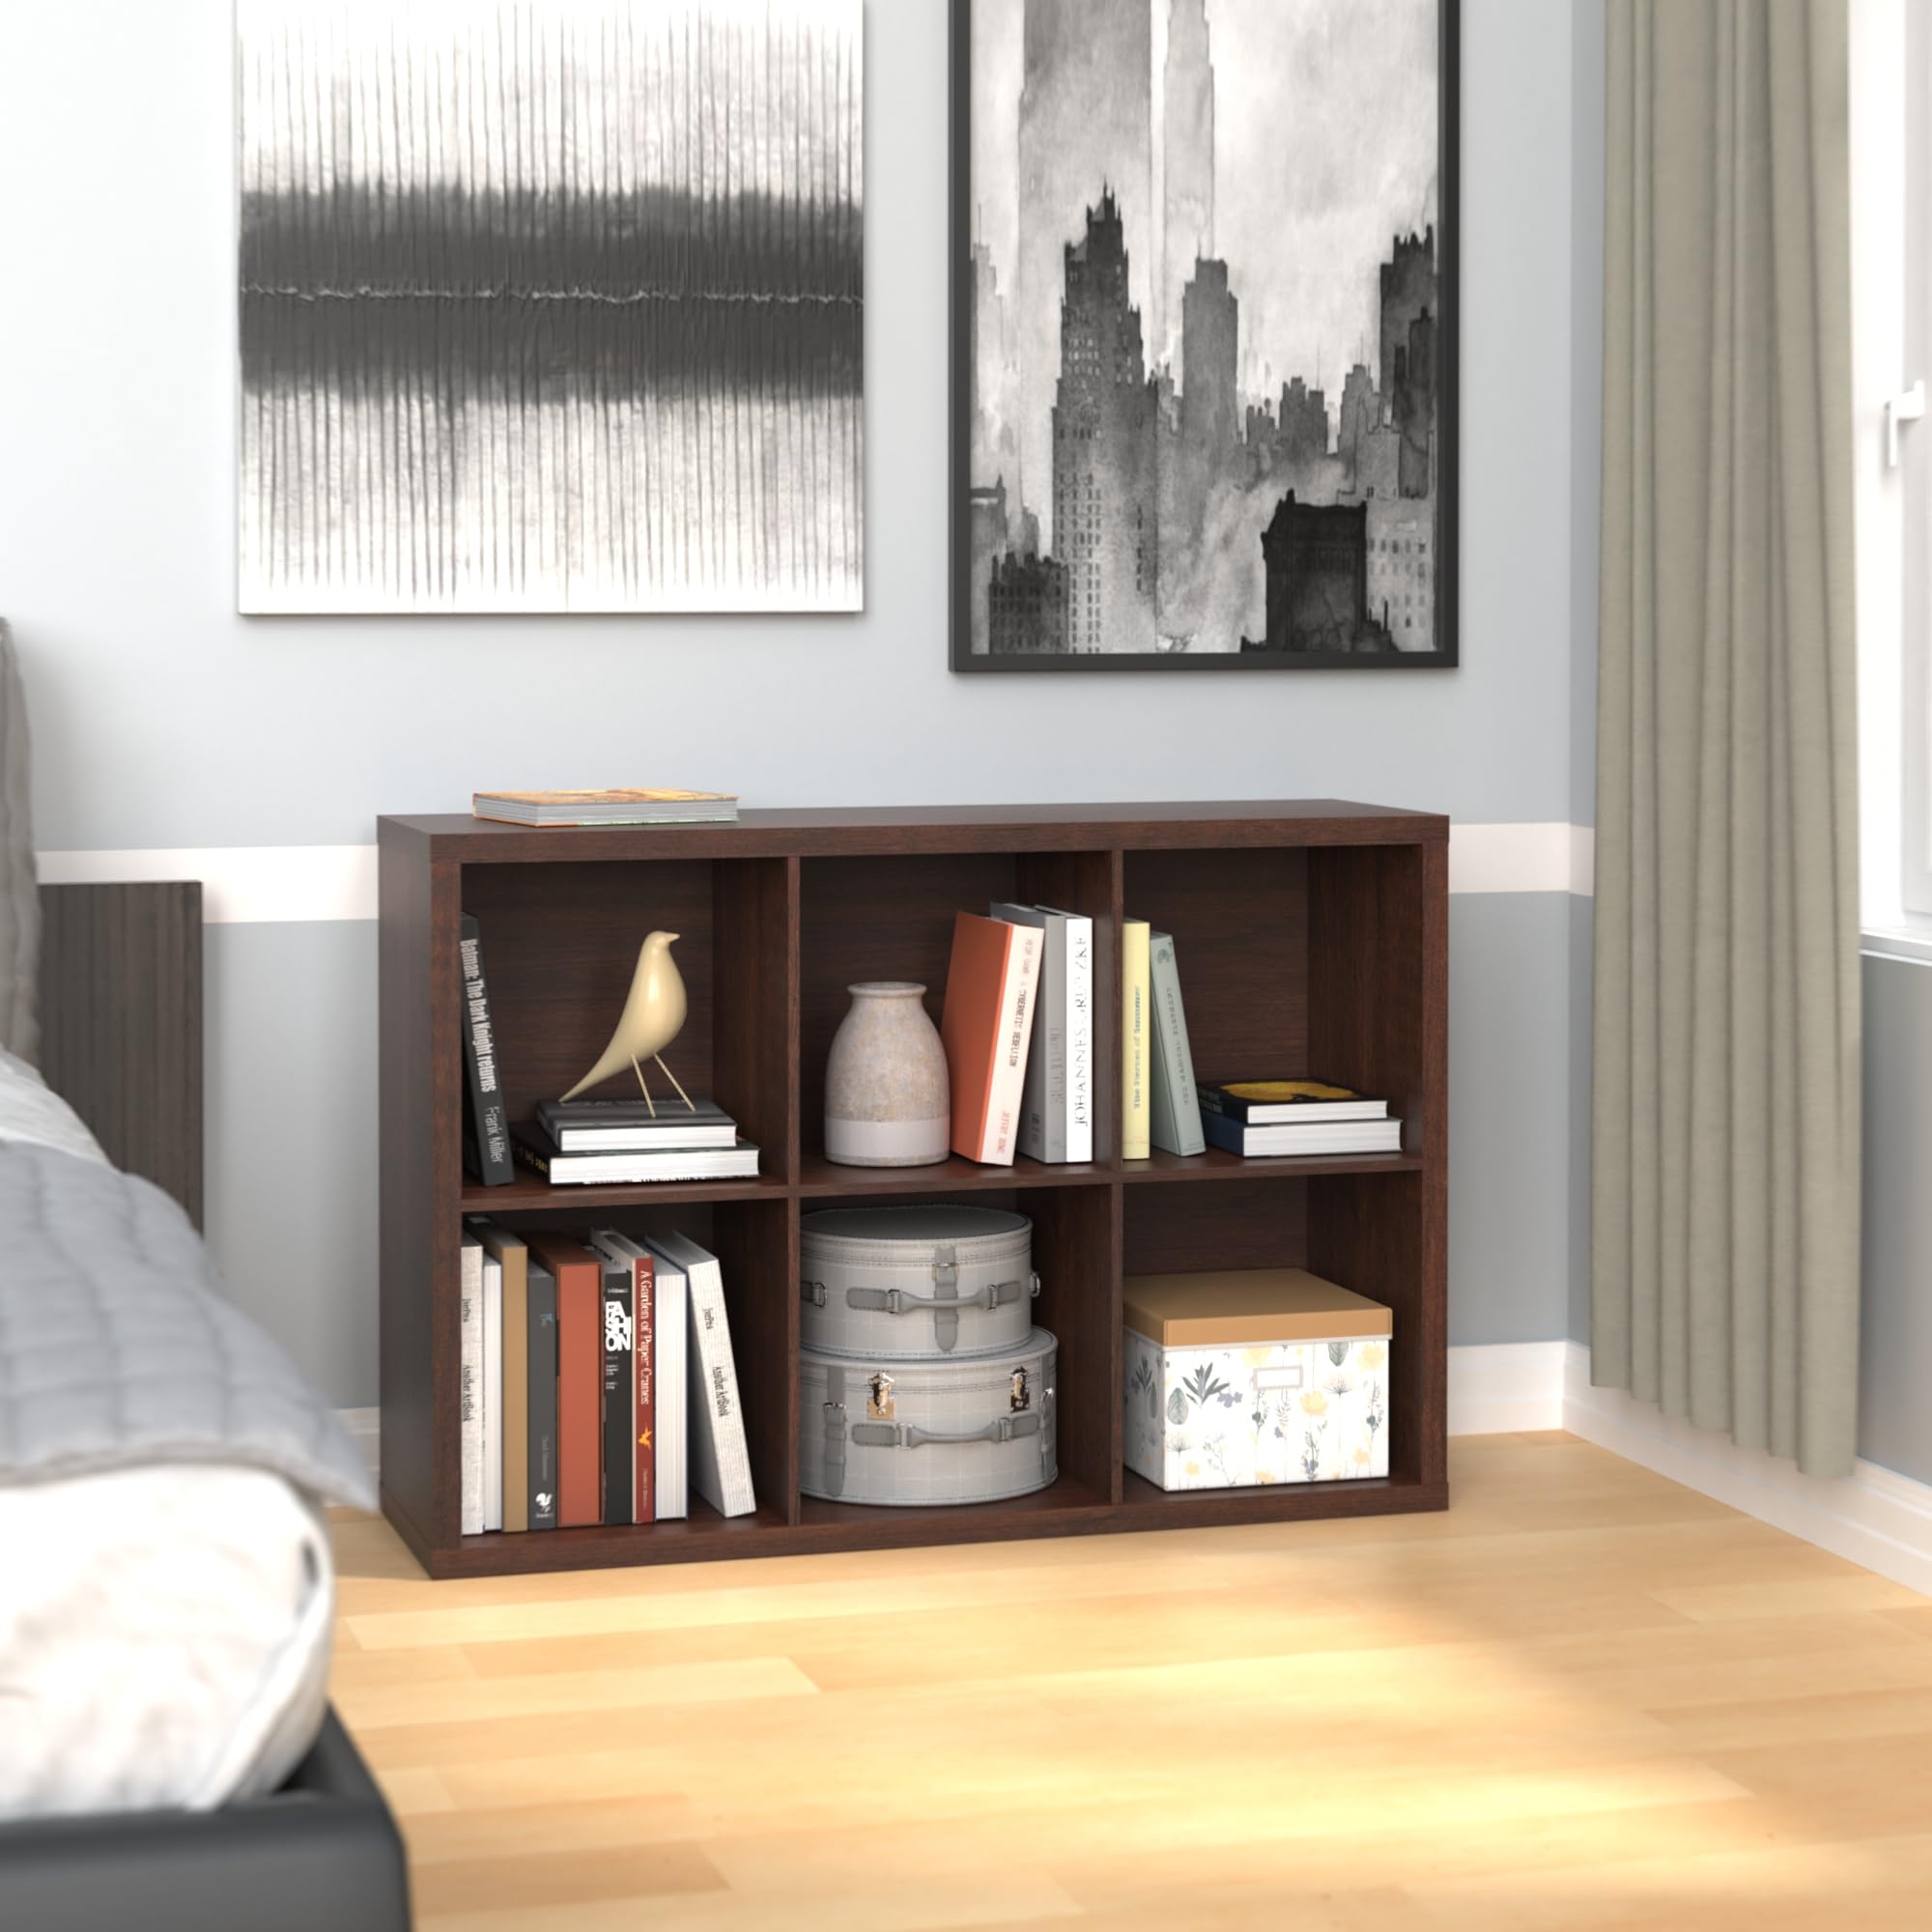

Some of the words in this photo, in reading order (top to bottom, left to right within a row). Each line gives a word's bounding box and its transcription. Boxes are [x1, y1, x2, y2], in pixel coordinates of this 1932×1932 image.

[460, 938, 480, 980] Batman:
[467, 979, 485, 999] The
[469, 998, 489, 1023] Dark
[472, 1022, 495, 1057] Knight
[478, 1055, 497, 1093] returns
[484, 1106, 501, 1136] Frank
[487, 1135, 505, 1164] Miller
[640, 1281, 653, 1320] Garden
[640, 1321, 652, 1334] of
[638, 1332, 652, 1368] Paper
[640, 1366, 652, 1406] Cranes
